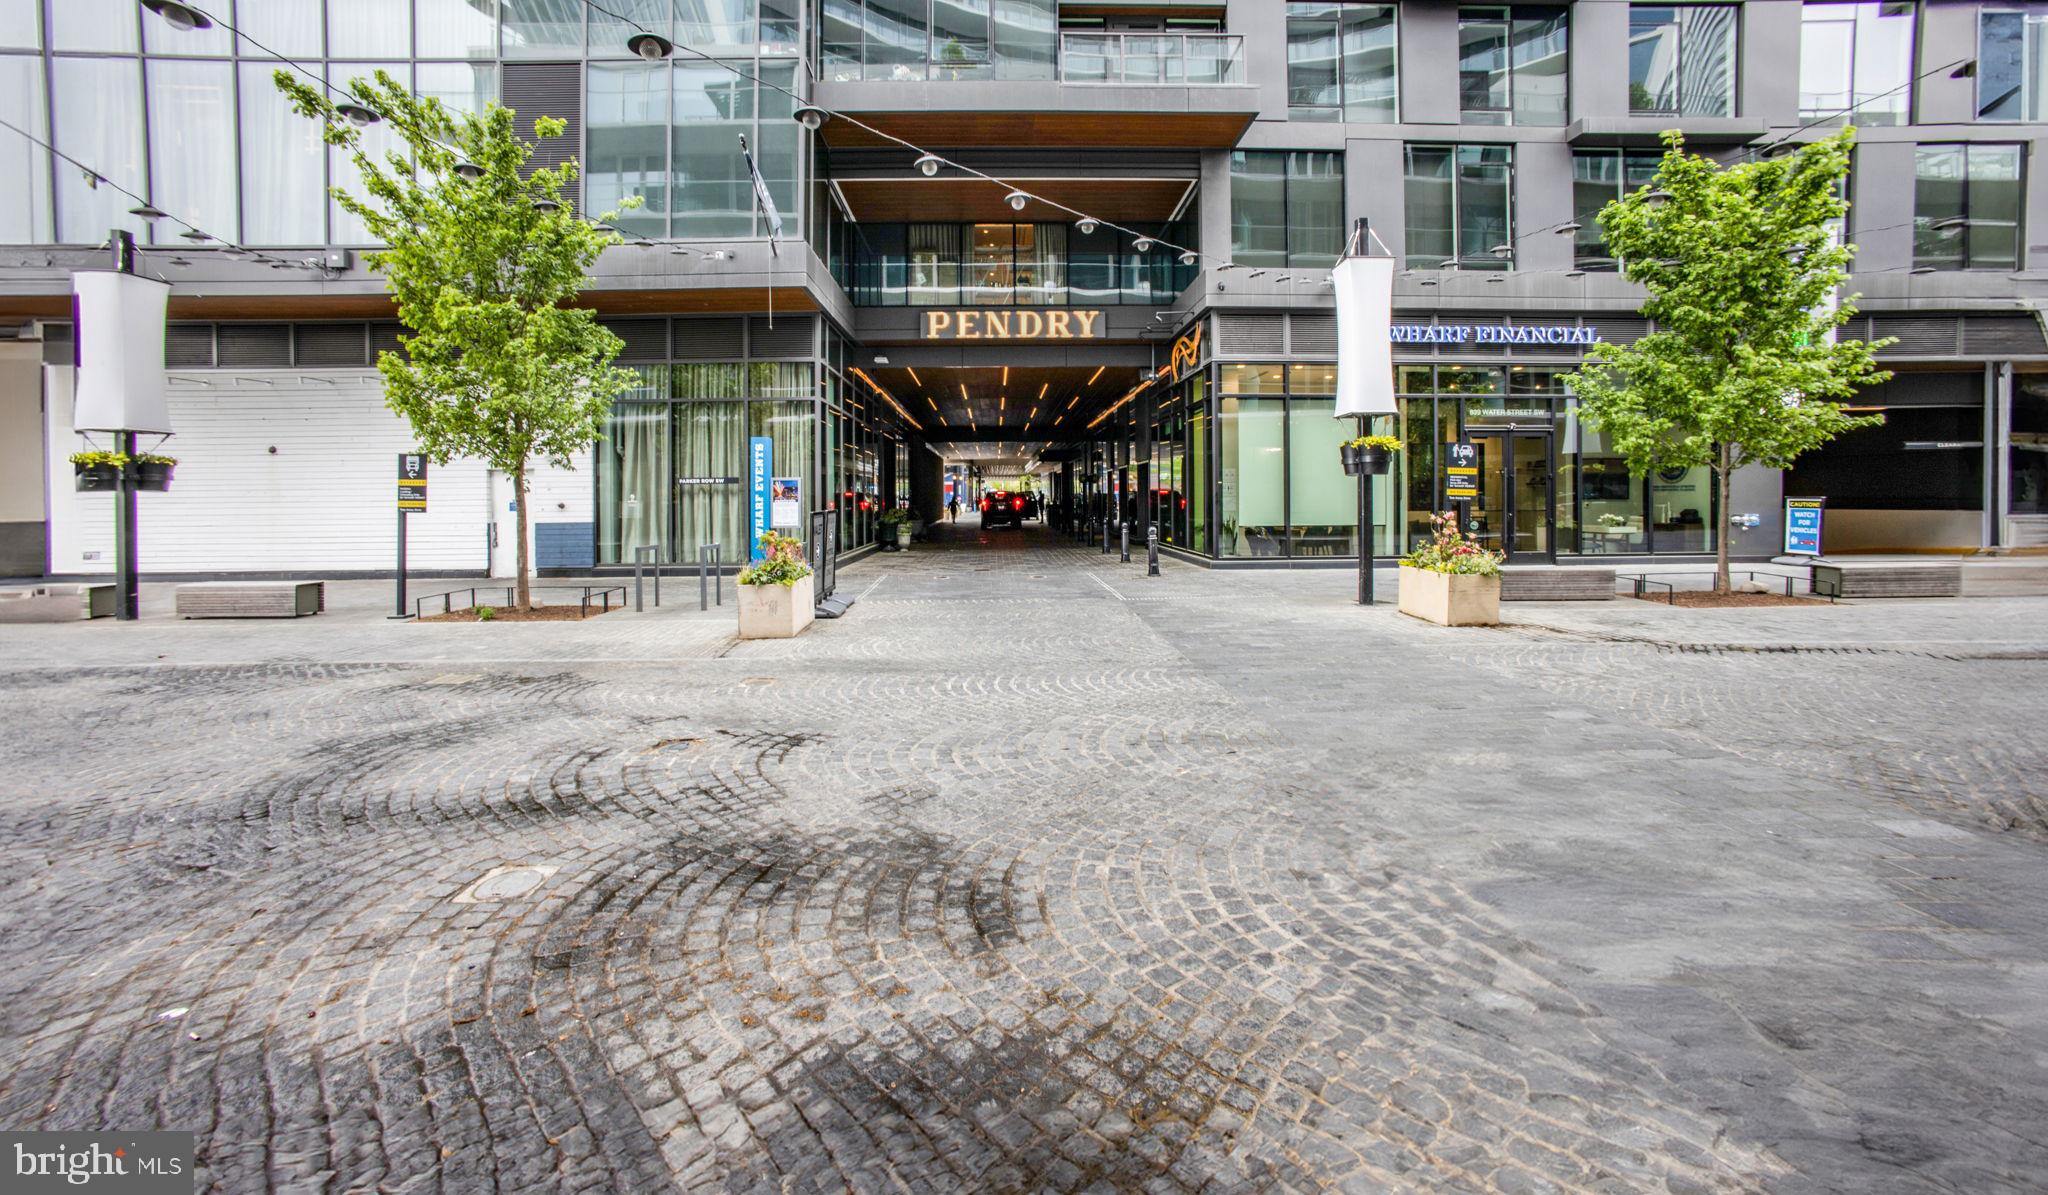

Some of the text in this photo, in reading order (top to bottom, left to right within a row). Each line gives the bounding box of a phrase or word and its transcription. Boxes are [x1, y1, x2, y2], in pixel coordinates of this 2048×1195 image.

[926, 310, 1100, 339] PENDRY
[1389, 325, 1602, 343] WHARF FINANCIAL
[1482, 408, 1506, 416] WATER
[1506, 408, 1532, 416] STREET
[754, 443, 765, 492] EVENTS
